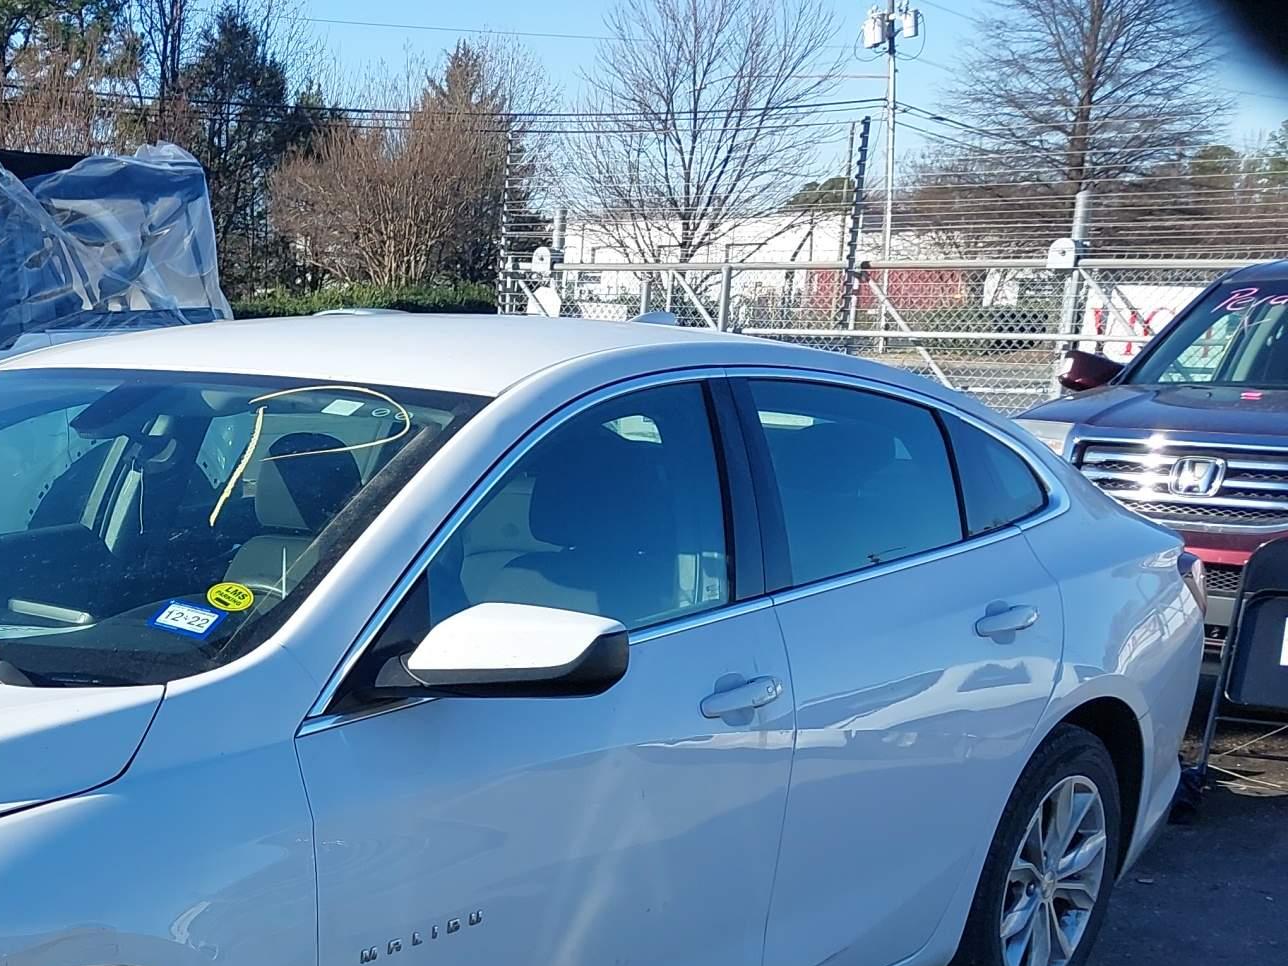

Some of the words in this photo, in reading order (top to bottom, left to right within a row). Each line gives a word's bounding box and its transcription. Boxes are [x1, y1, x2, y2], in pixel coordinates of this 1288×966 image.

[215, 589, 242, 606] PARKING
[225, 586, 248, 601] LMS
[359, 908, 483, 965] MALIBU
